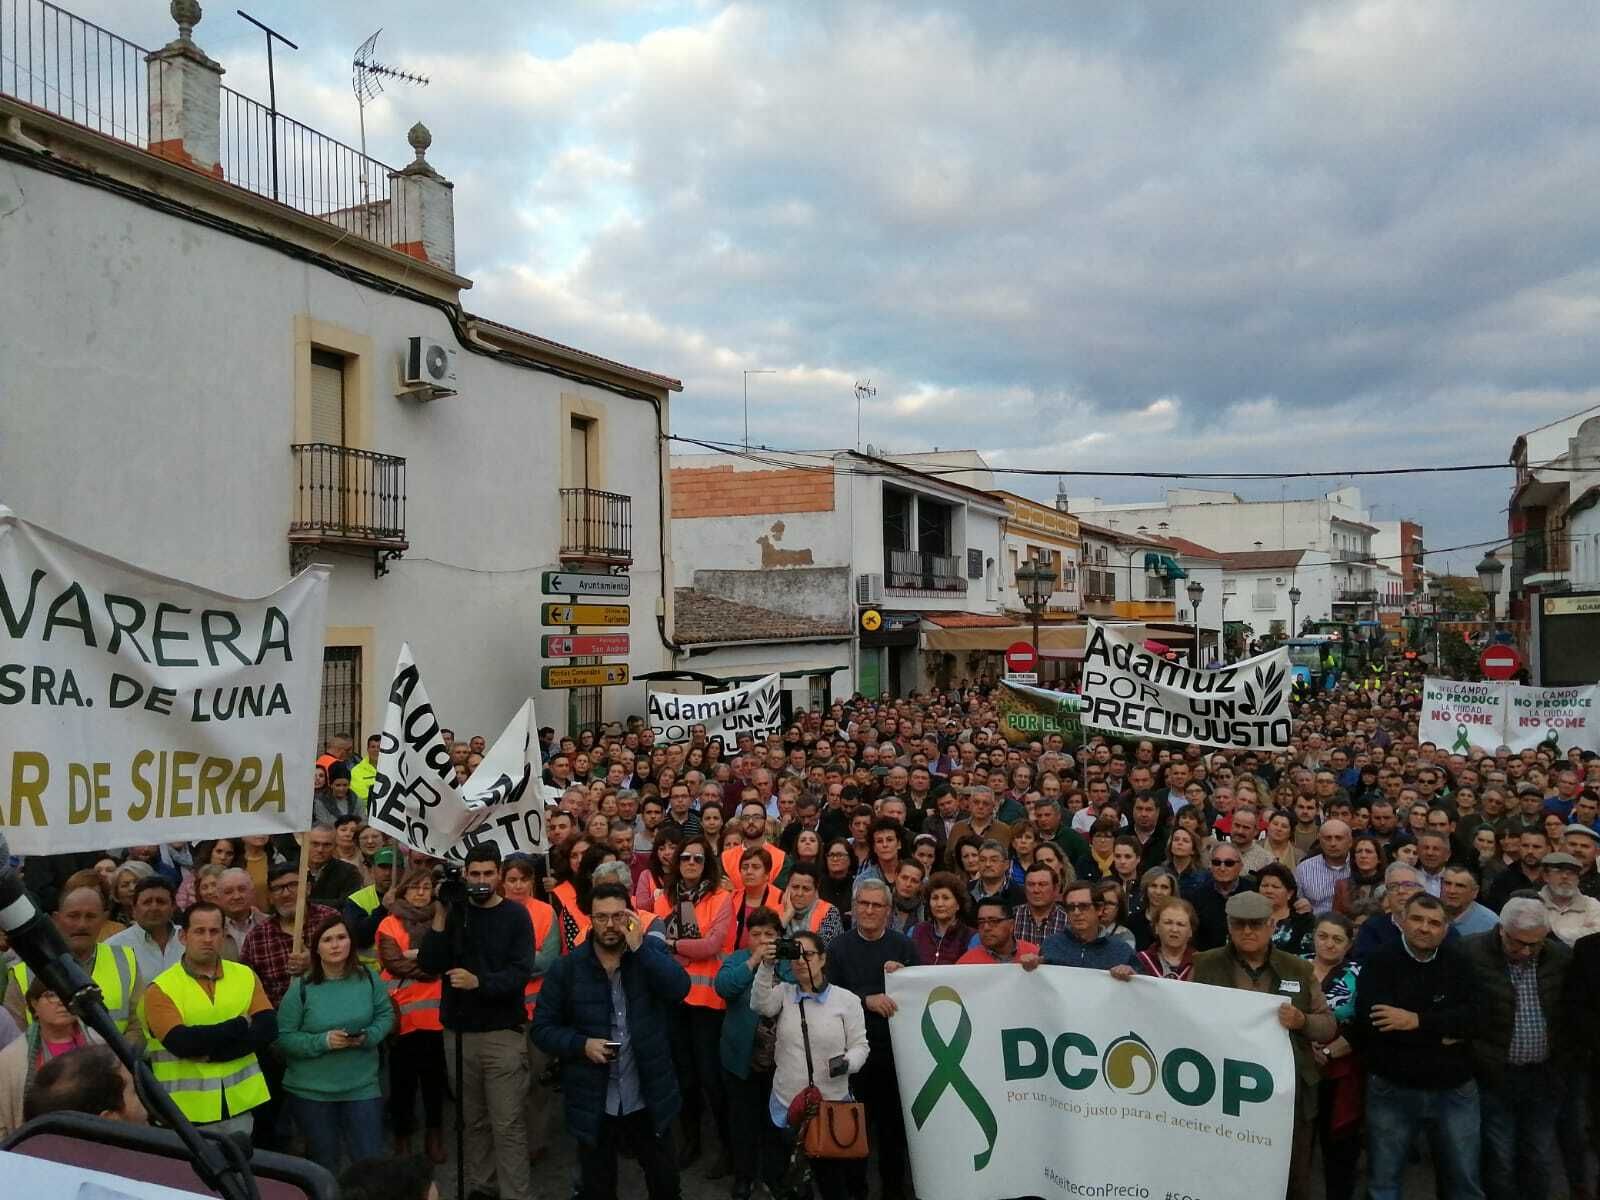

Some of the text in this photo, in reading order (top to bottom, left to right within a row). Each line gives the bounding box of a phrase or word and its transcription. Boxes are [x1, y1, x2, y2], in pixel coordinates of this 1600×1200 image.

[579, 580, 628, 591] Ayuntamiento
[1084, 626, 1238, 693] Adamuz
[0, 664, 291, 722] SRA. DE LUNA
[1085, 671, 1162, 707] POR
[1190, 699, 1236, 719] UN
[1427, 692, 1500, 705] NO PRODUCE
[1454, 685, 1488, 695] CAMPO
[1542, 690, 1578, 699] CAMPO
[649, 691, 749, 721] Adamuz
[1514, 698, 1592, 708] NO PRODUCE
[723, 713, 753, 731] UN
[1007, 713, 1038, 731] POR
[1043, 714, 1061, 731] EL
[1431, 710, 1493, 725] NO COME
[1519, 717, 1586, 728] NO COME
[0, 750, 49, 827] R
[68, 762, 112, 825] DE
[127, 749, 287, 822] SIERRA
[1001, 1026, 1274, 1117] DCOOP
[1007, 1091, 1272, 1147] Por un precio justo para el aceite de oliva
[1044, 1167, 1149, 1199] #AceiteconPrecio
